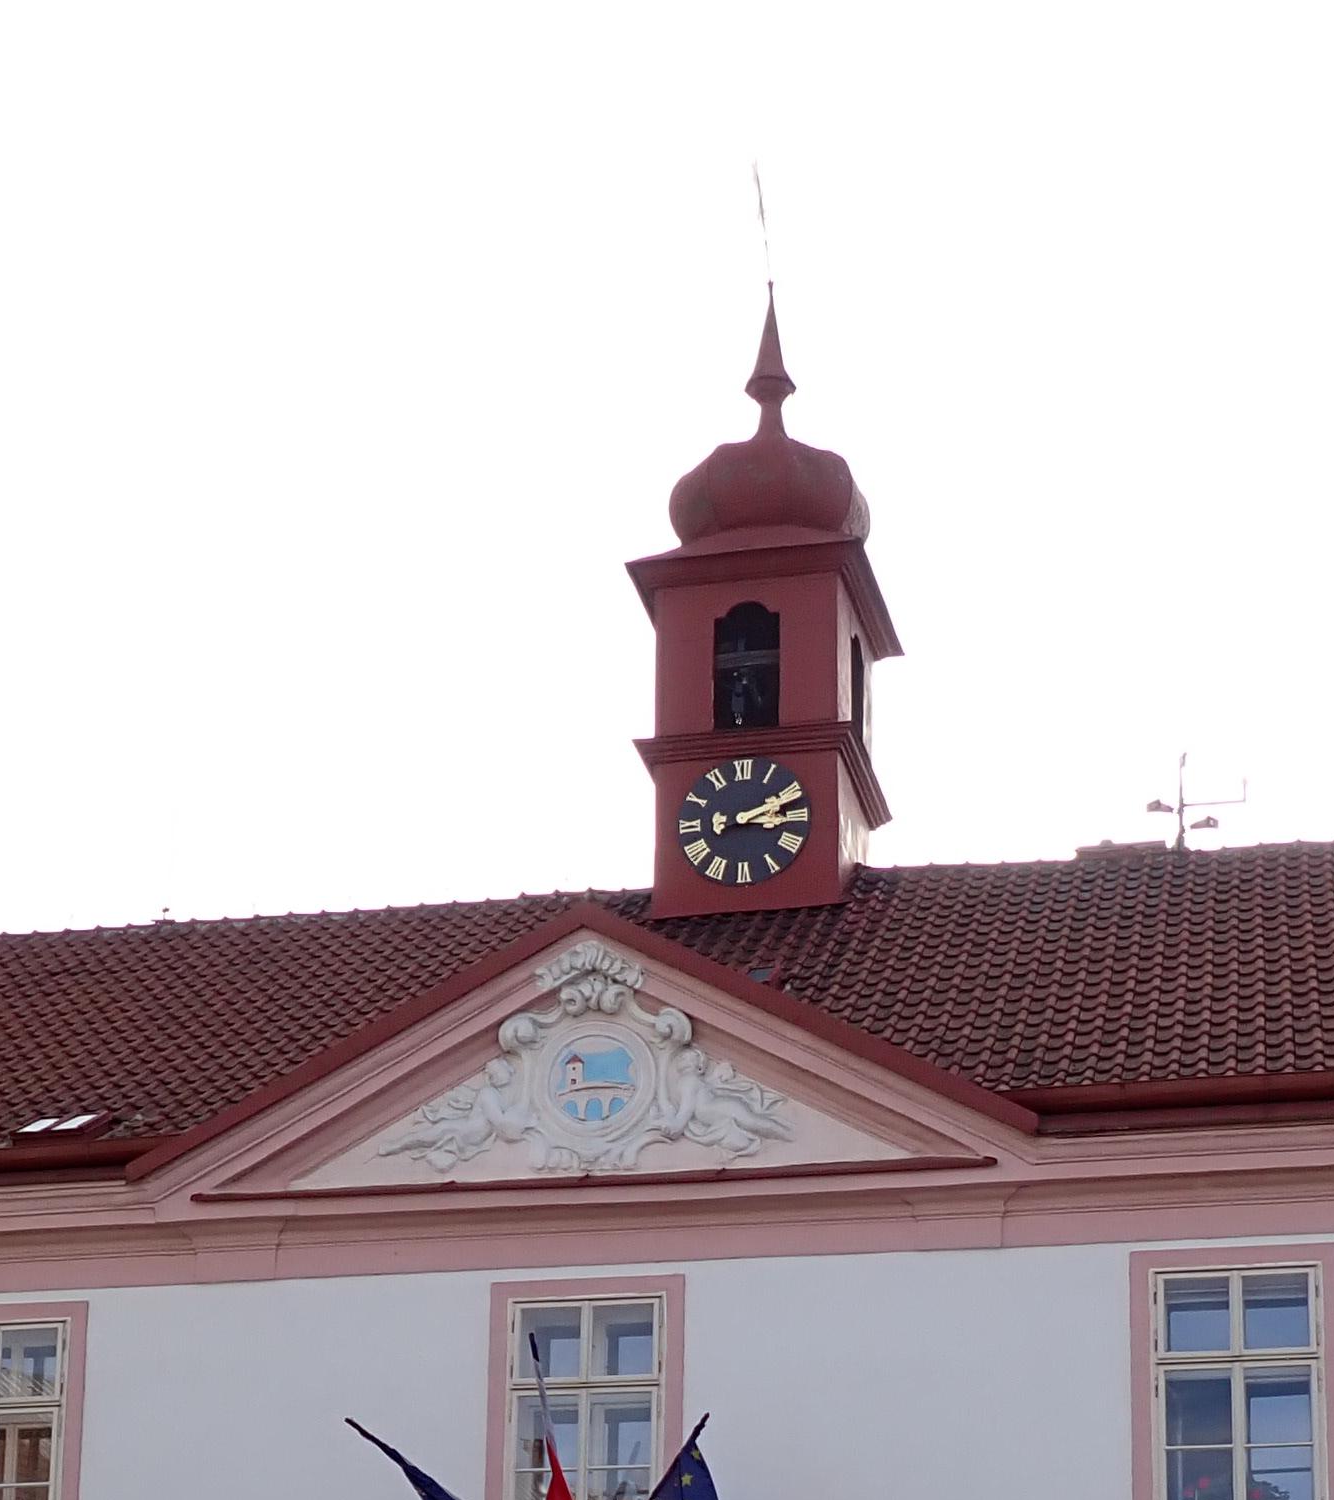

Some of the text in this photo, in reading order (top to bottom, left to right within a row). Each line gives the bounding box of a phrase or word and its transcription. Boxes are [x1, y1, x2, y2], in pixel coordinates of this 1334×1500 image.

[705, 768, 727, 792] XI
[733, 759, 753, 781] XII
[685, 792, 707, 808] X
[679, 819, 701, 834] IX
[705, 855, 728, 880] VII
[736, 861, 752, 883] VI
[763, 853, 780, 874] V
